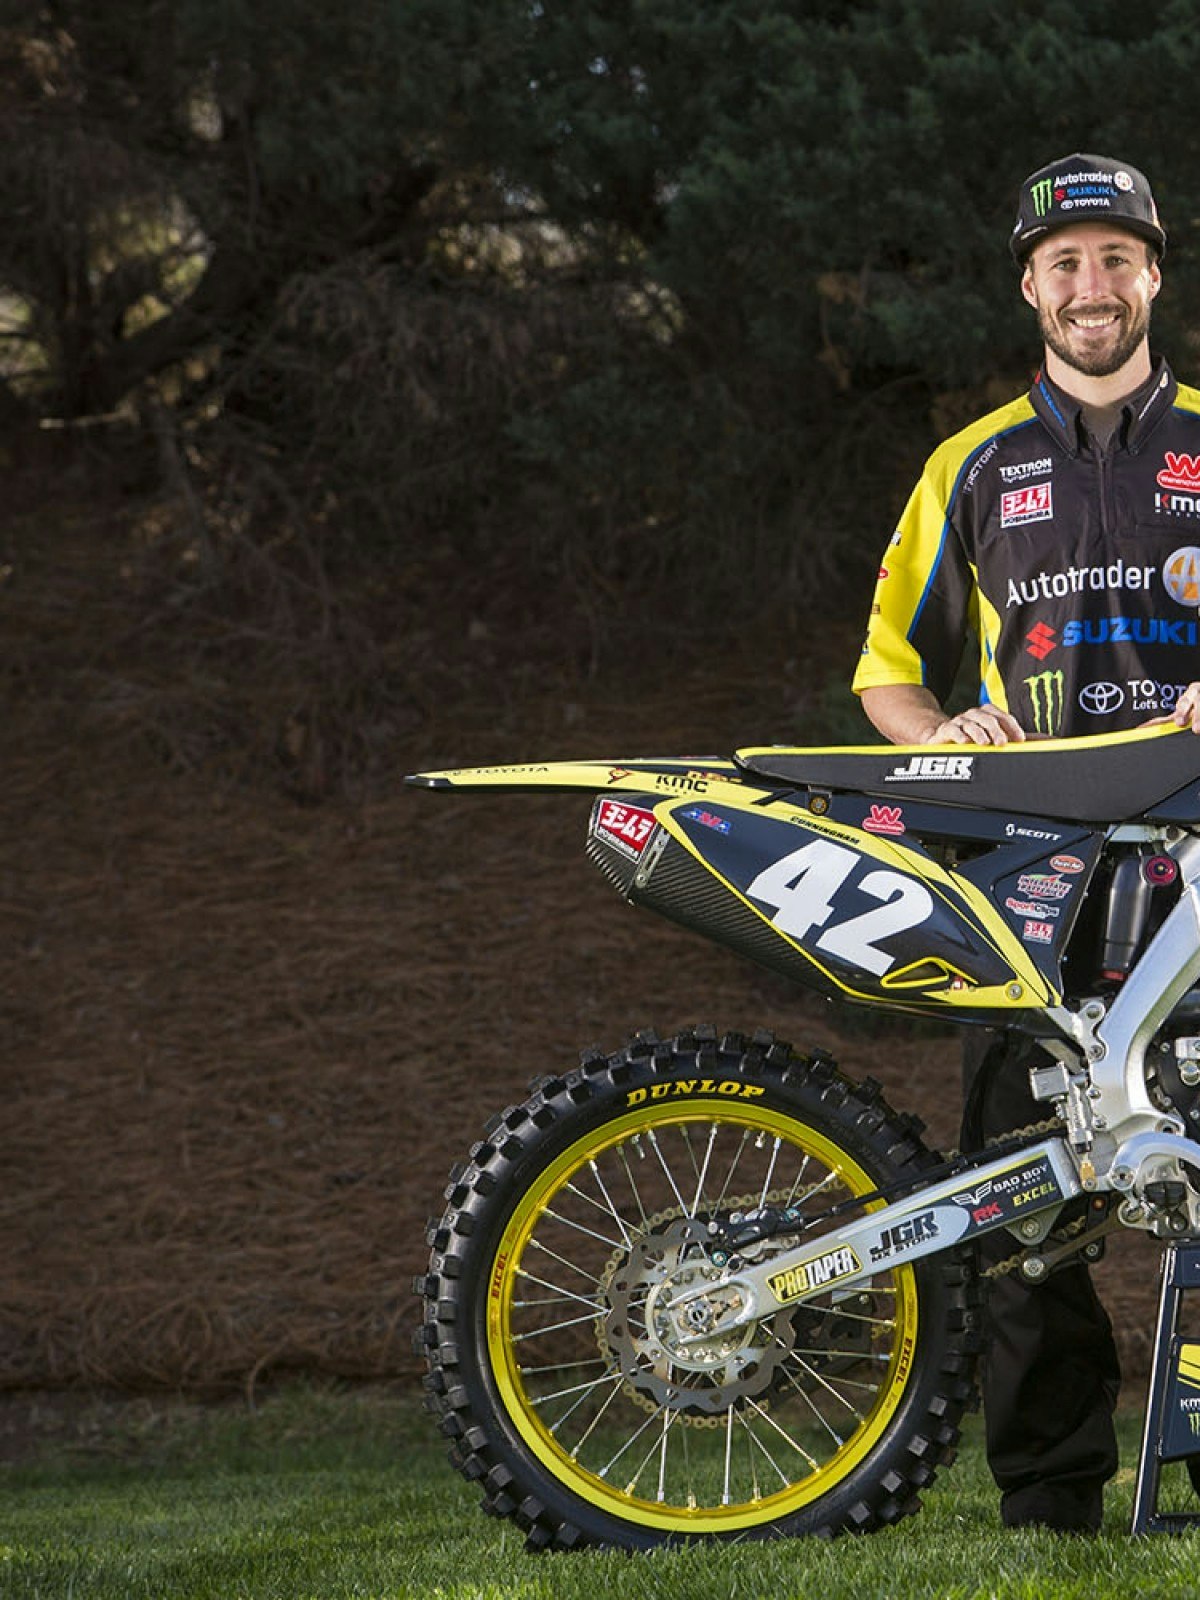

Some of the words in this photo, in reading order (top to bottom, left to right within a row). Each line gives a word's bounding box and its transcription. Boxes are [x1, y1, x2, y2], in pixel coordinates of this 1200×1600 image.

[1054, 171, 1112, 188] Autotrader
[1066, 186, 1118, 198] SUZUKI
[1073, 198, 1111, 208] TOYOTA
[999, 457, 1052, 479] TEXTRON
[1005, 558, 1156, 609] Autotrader
[1062, 616, 1198, 648] SUZUKI
[893, 756, 974, 777] JGR
[1015, 828, 1062, 841] SCOTT
[745, 838, 934, 977] 42
[626, 1079, 766, 1108] DUNLOP
[993, 1175, 1020, 1193] BAD
[1021, 1163, 1048, 1181] BOY
[1012, 1181, 1056, 1208] EXCEL
[972, 1201, 1003, 1223] RK
[868, 1211, 941, 1255] JGR
[769, 1251, 859, 1301] PROTAPER
